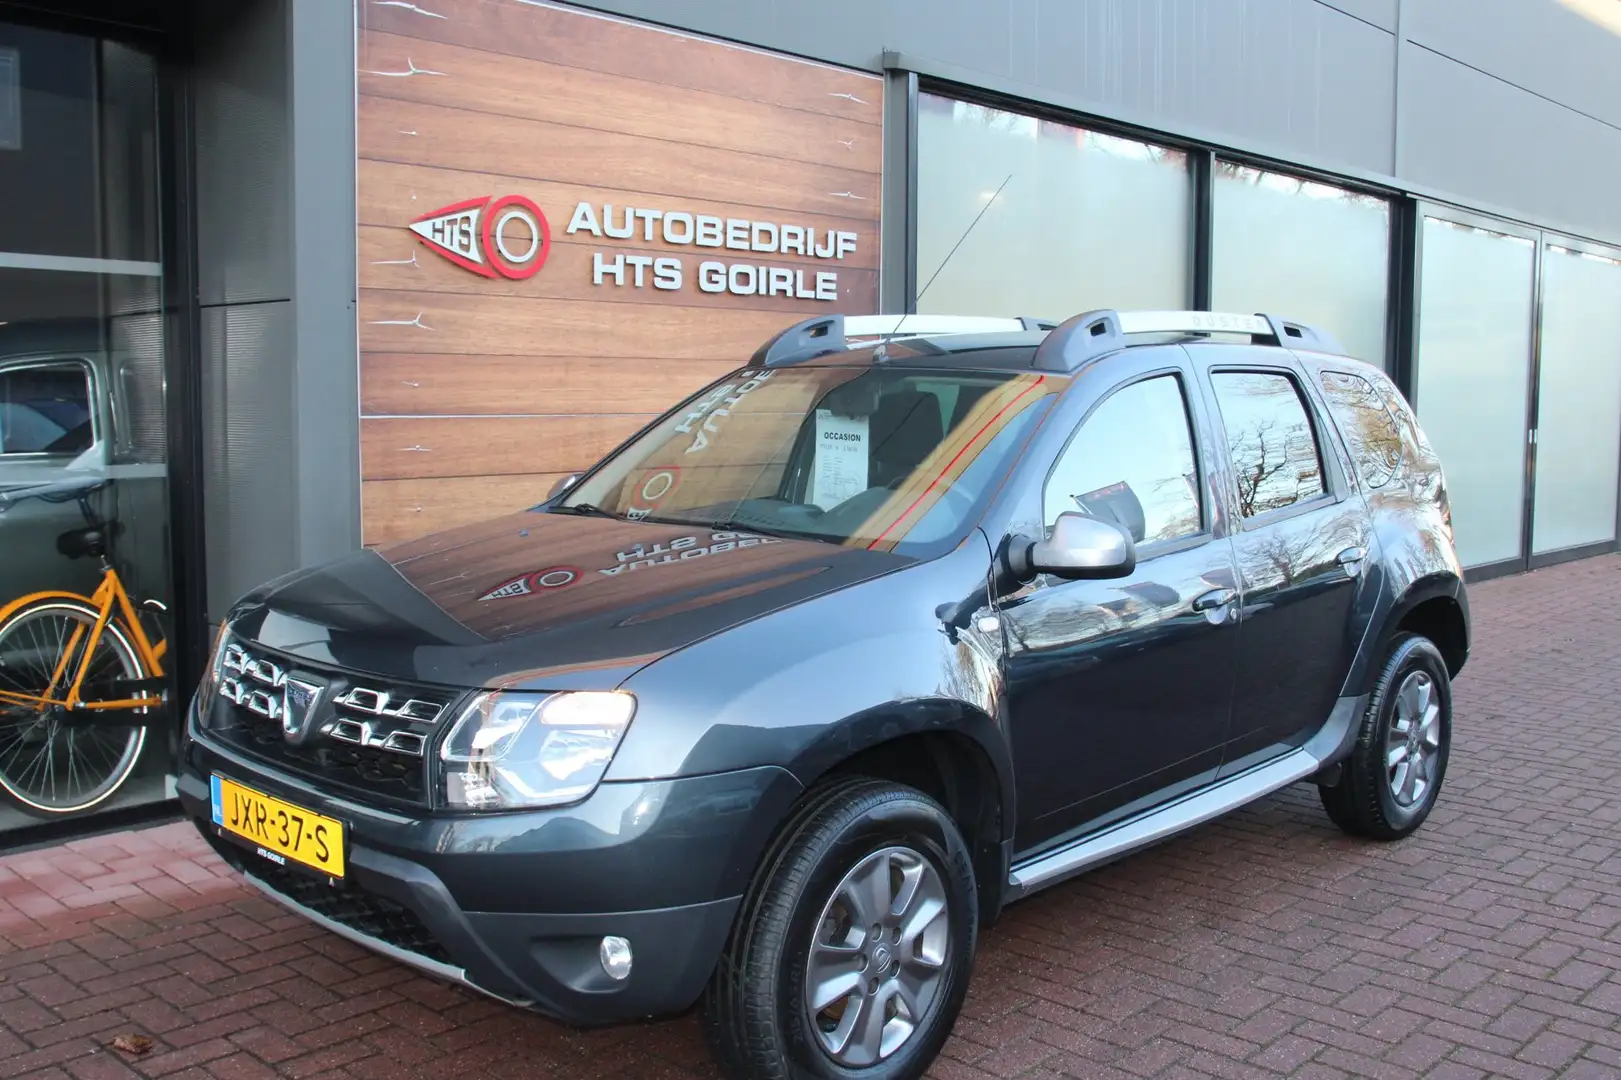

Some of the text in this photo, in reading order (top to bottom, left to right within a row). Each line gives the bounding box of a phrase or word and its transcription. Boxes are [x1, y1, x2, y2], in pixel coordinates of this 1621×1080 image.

[430, 215, 472, 254] HTS
[566, 201, 858, 259] AUTOBEDRIJF
[592, 252, 838, 300] HTS GOIRLE
[1191, 315, 1266, 331] DUSTER
[824, 431, 861, 442] OCCASION
[231, 792, 329, 863] JXR-37-S
